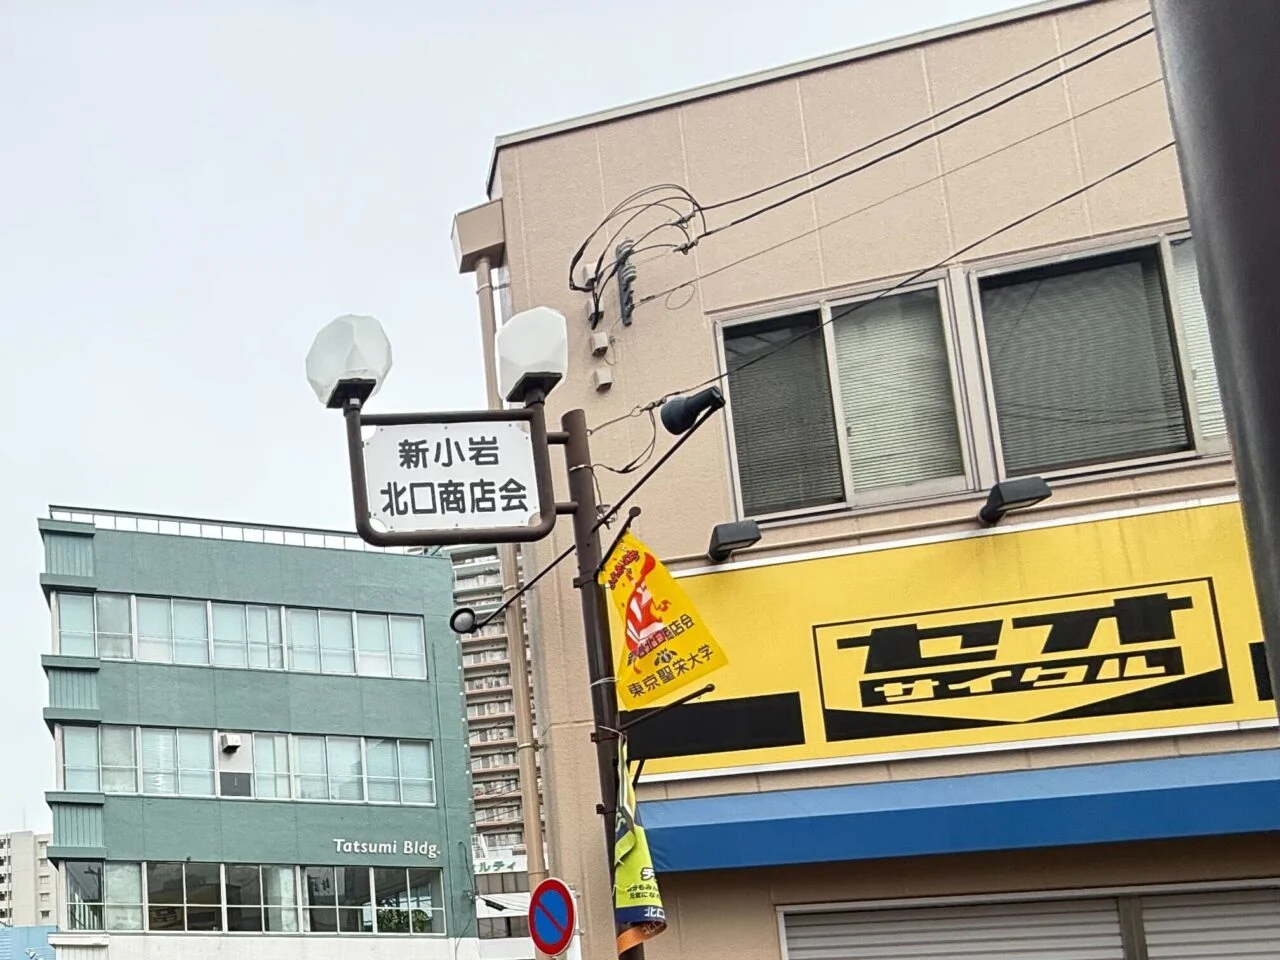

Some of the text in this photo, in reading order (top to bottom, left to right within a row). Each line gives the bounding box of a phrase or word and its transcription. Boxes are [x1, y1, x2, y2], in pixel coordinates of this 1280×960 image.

[398, 436, 499, 469] 新小岩
[380, 478, 528, 516] 北口商店会
[836, 592, 1193, 674] セオ
[627, 643, 714, 698] 東京聖栄大学
[873, 655, 1166, 703] サイクル
[333, 838, 441, 859] Tatsumi Bldg.
[472, 860, 517, 873] ルティ
